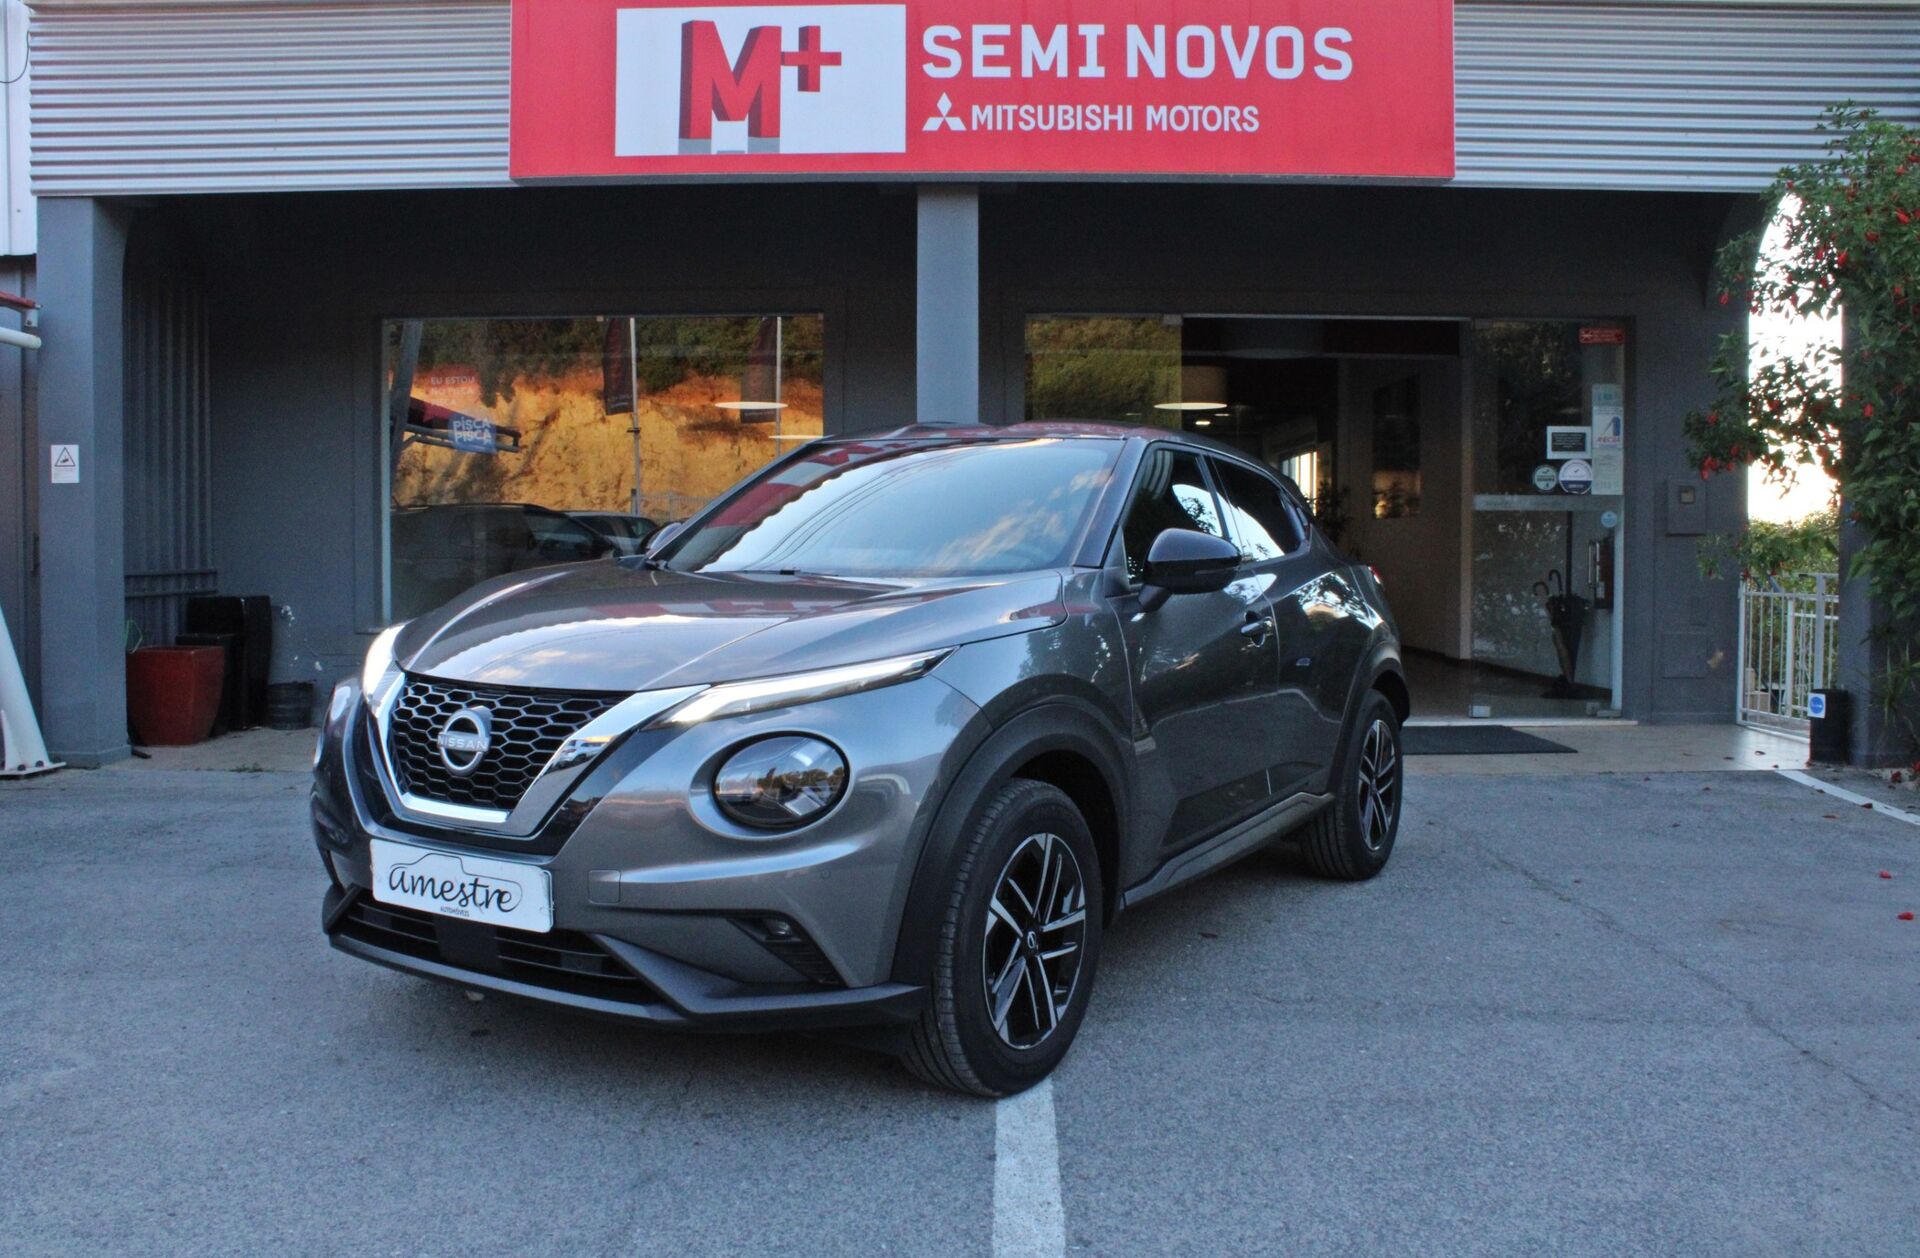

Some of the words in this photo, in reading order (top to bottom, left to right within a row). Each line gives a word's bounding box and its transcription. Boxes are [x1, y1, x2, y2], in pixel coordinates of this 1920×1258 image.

[922, 24, 1105, 79] SEMI
[1126, 24, 1353, 81] NOVOS
[971, 104, 1133, 131] MITSUBISHI
[1146, 105, 1259, 132] MOTORS
[438, 735, 488, 751] NISSAN
[388, 865, 514, 913] amestre
